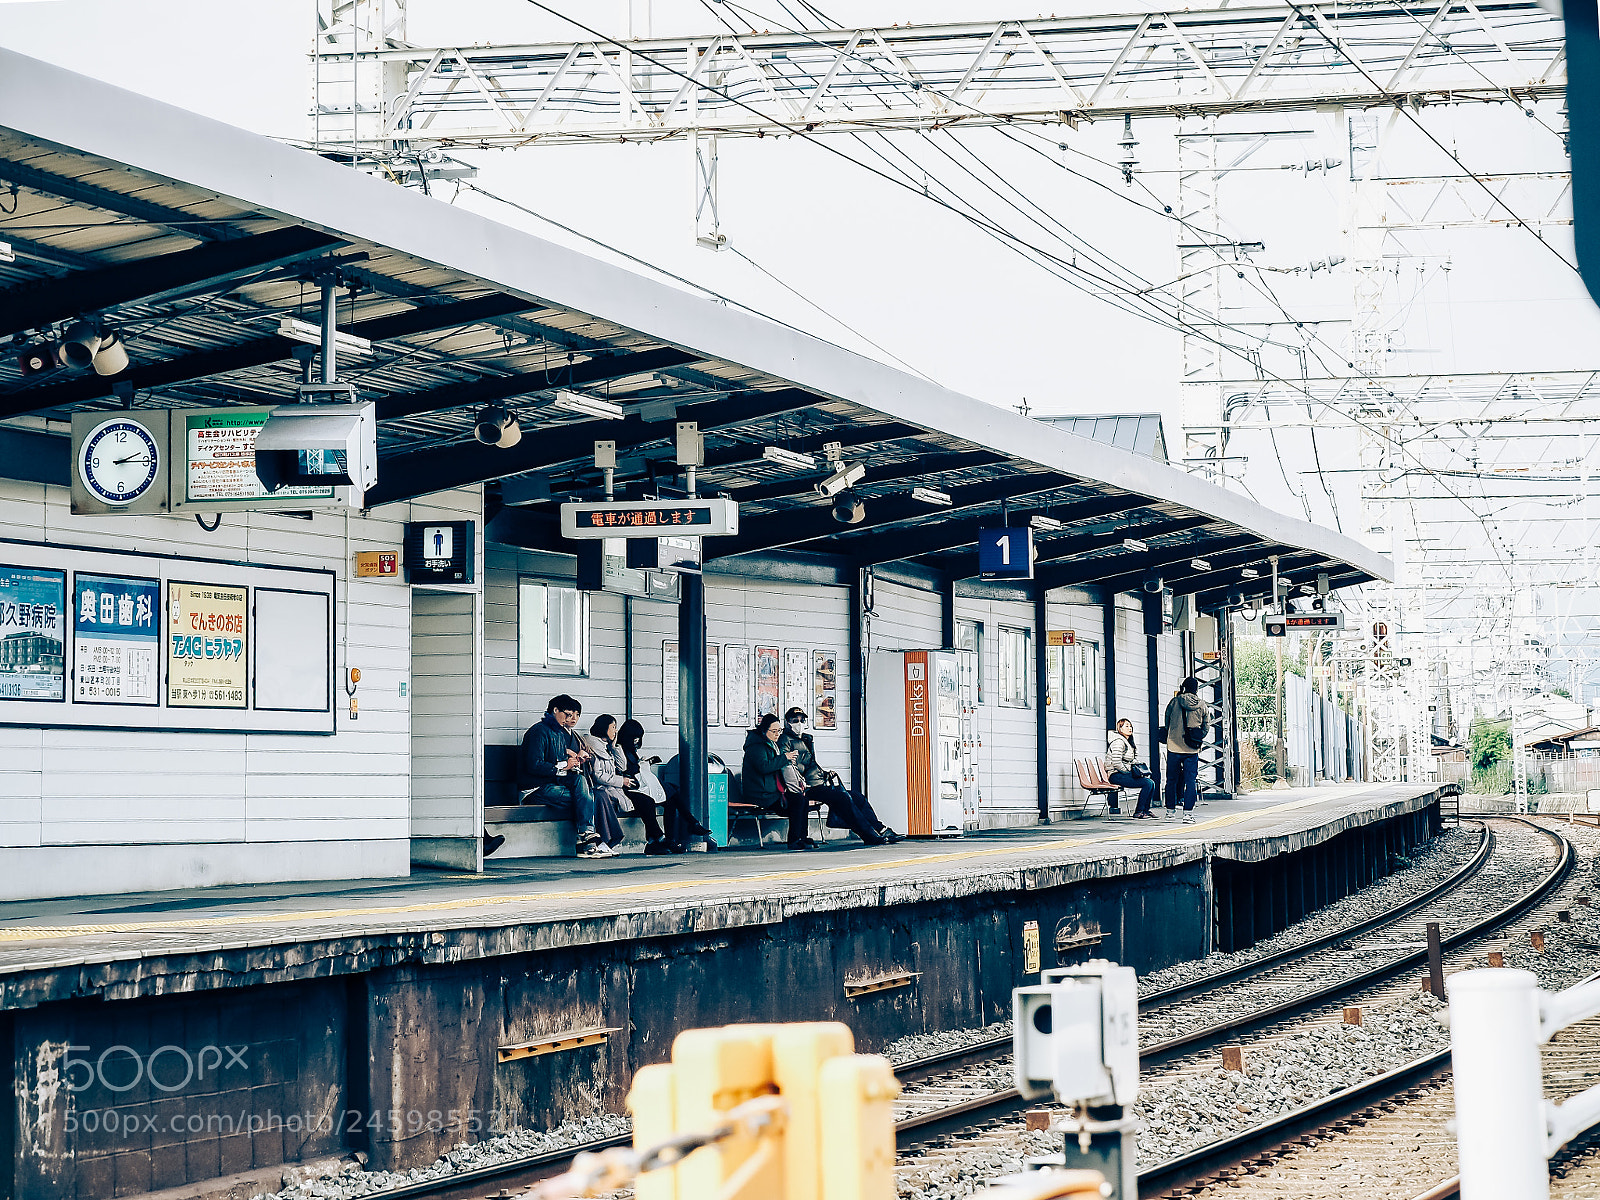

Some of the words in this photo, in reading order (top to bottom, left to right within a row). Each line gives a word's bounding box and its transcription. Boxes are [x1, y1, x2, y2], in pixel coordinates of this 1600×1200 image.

[115, 432, 127, 443] 12
[92, 457, 100, 468] 9
[142, 456, 150, 467] 3
[117, 482, 125, 492] 6
[591, 510, 696, 526] 電車が通過します
[996, 536, 1010, 565] 1
[425, 560, 451, 568] お手洗い
[80, 588, 153, 628] 奥田歯科
[190, 612, 243, 634] でんきのお店
[172, 634, 203, 659] TAG
[205, 636, 243, 661] ヒラヤマ
[909, 684, 925, 736] Drinks
